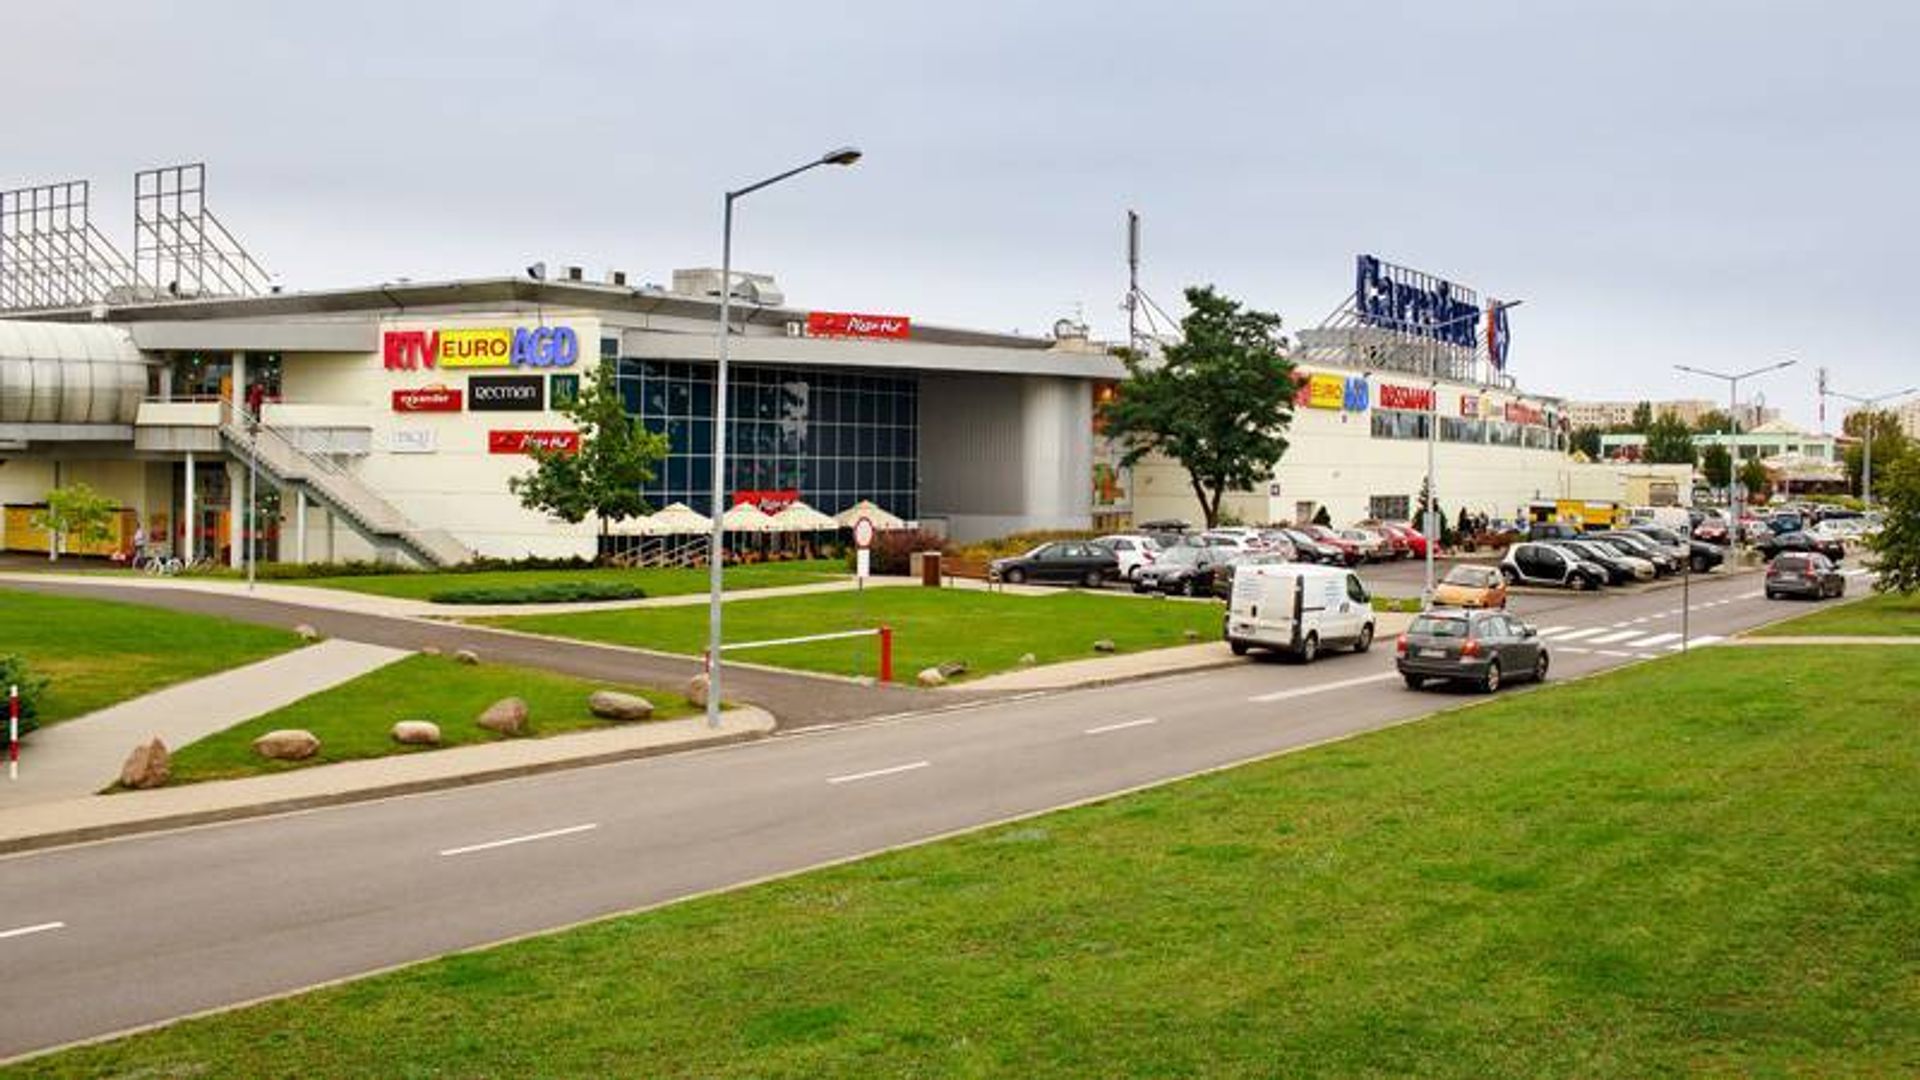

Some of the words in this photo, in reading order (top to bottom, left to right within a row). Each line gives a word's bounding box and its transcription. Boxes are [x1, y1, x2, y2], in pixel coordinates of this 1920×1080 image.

[384, 331, 440, 370] RTV
[442, 338, 508, 358] EURO
[511, 326, 578, 369] AGD
